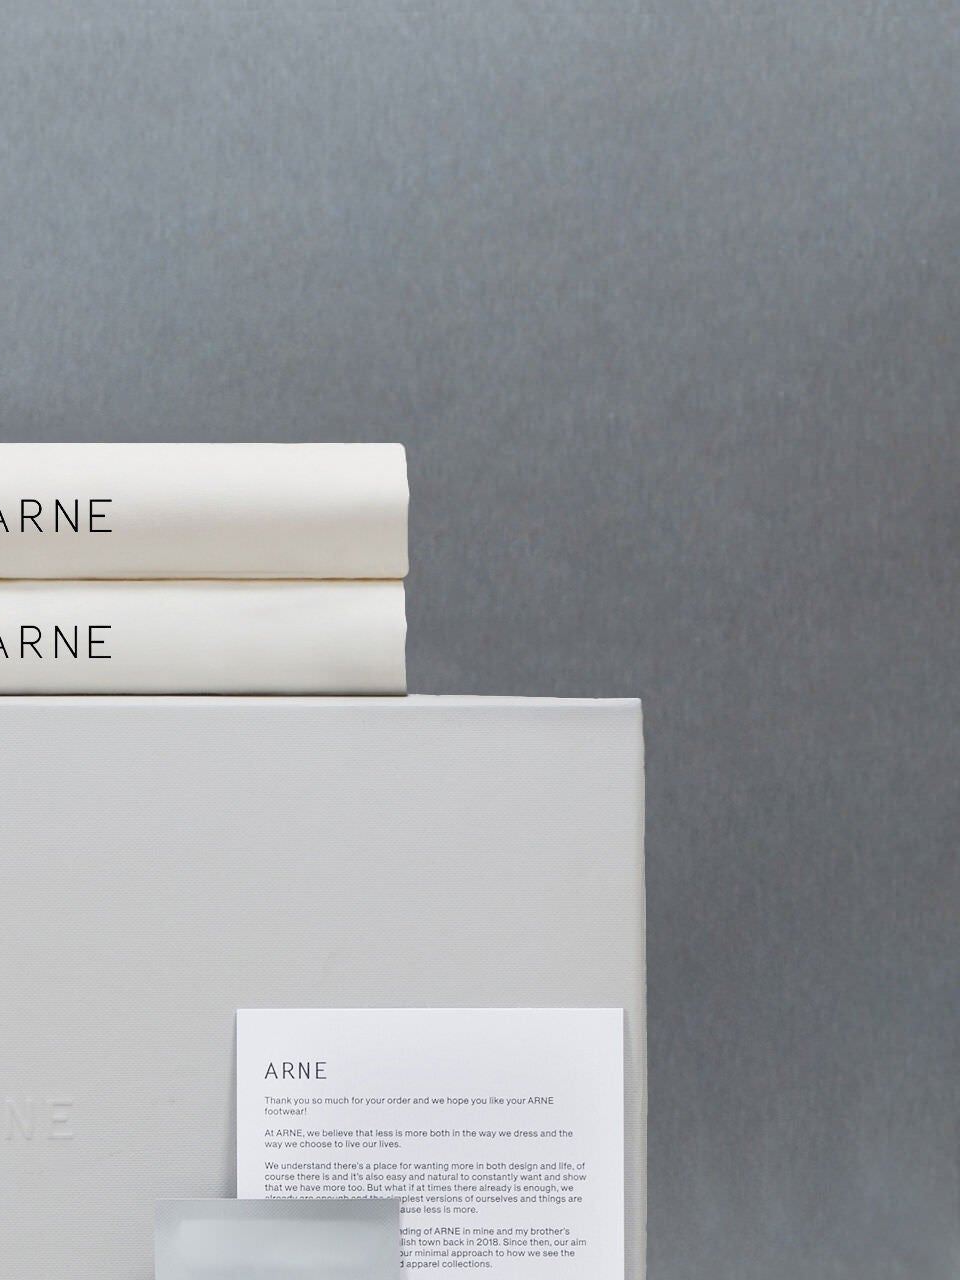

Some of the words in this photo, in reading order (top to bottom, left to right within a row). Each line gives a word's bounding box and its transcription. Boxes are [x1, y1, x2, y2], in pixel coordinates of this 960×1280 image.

[264, 1061, 328, 1080] ARNE
[264, 1096, 292, 1105] Thank
[293, 1098, 310, 1107] you
[324, 1096, 350, 1105] much
[351, 1096, 364, 1105] for
[365, 1098, 386, 1107] your
[386, 1096, 411, 1105] order
[412, 1096, 430, 1105] and
[446, 1096, 469, 1107] hope
[470, 1098, 487, 1107] you
[489, 1096, 505, 1105] like
[506, 1098, 527, 1107] your
[527, 1096, 554, 1105] ARNE
[264, 1107, 307, 1116] footwear!
[264, 1129, 274, 1138] At
[275, 1129, 305, 1139] ARNE,
[322, 1129, 354, 1138] believe
[355, 1129, 374, 1138] that
[375, 1129, 394, 1138] less
[395, 1129, 403, 1138] is
[429, 1129, 450, 1138] both
[452, 1129, 461, 1138] in
[462, 1129, 477, 1138] the
[478, 1131, 497, 1140] way
[513, 1129, 539, 1138] dress
[540, 1129, 557, 1138] and
[558, 1129, 574, 1138] the
[264, 1142, 283, 1151] way
[299, 1140, 333, 1149] choose
[334, 1140, 344, 1149] to
[345, 1140, 361, 1149] live
[379, 1140, 402, 1149] lives.
[264, 1162, 279, 1171] We
[280, 1162, 332, 1171] understand
[333, 1162, 364, 1171] there's
[373, 1162, 398, 1173] place
[399, 1162, 412, 1171] for
[413, 1162, 449, 1173] wanting
[476, 1162, 484, 1171] in
[486, 1162, 507, 1171] both
[508, 1162, 539, 1173] design
[539, 1162, 557, 1171] and
[558, 1162, 575, 1172] life,
[576, 1162, 586, 1171] of
[296, 1173, 321, 1182] there
[322, 1173, 330, 1182] is
[331, 1173, 349, 1182] and
[350, 1173, 364, 1182] it's
[365, 1173, 385, 1182] also
[385, 1175, 407, 1184] easy
[408, 1173, 426, 1182] and
[427, 1173, 459, 1182] natural
[460, 1173, 470, 1182] to
[471, 1173, 519, 1184] constantly
[519, 1173, 542, 1182] want
[543, 1173, 561, 1182] and
[562, 1173, 587, 1182] show
[264, 1184, 283, 1193] that
[299, 1184, 321, 1193] have
[347, 1184, 365, 1193] too.
[366, 1184, 383, 1193] But
[384, 1184, 407, 1193] what
[408, 1184, 415, 1193] if
[416, 1184, 425, 1193] at
[427, 1184, 452, 1193] times
[453, 1184, 478, 1193] there
[478, 1184, 513, 1195] already
[513, 1184, 522, 1193] is
[523, 1184, 559, 1195] enough,
[425, 1194, 463, 1203] versions
[464, 1194, 474, 1203] of
[475, 1194, 518, 1203] ourselves
[519, 1194, 537, 1203] and
[538, 1194, 567, 1205] things
[423, 1205, 442, 1214] less
[443, 1205, 452, 1214] is
[423, 1227, 433, 1236] of
[433, 1227, 461, 1236] ARNE
[462, 1227, 471, 1236] in
[472, 1227, 495, 1236] mine
[496, 1227, 513, 1236] and
[515, 1229, 529, 1238] my
[530, 1227, 571, 1236] brother's
[418, 1238, 441, 1247] town
[442, 1238, 465, 1247] back
[466, 1238, 475, 1247] in
[476, 1238, 501, 1247] 2018.
[502, 1238, 528, 1247] Since
[529, 1238, 552, 1248] then,
[570, 1238, 587, 1247] aim
[414, 1248, 449, 1257] minimal
[450, 1248, 494, 1259] approach
[495, 1248, 505, 1257] to
[506, 1248, 526, 1257] how
[560, 1248, 576, 1257] the
[405, 1259, 440, 1270] apparel
[441, 1259, 493, 1268] collections.
